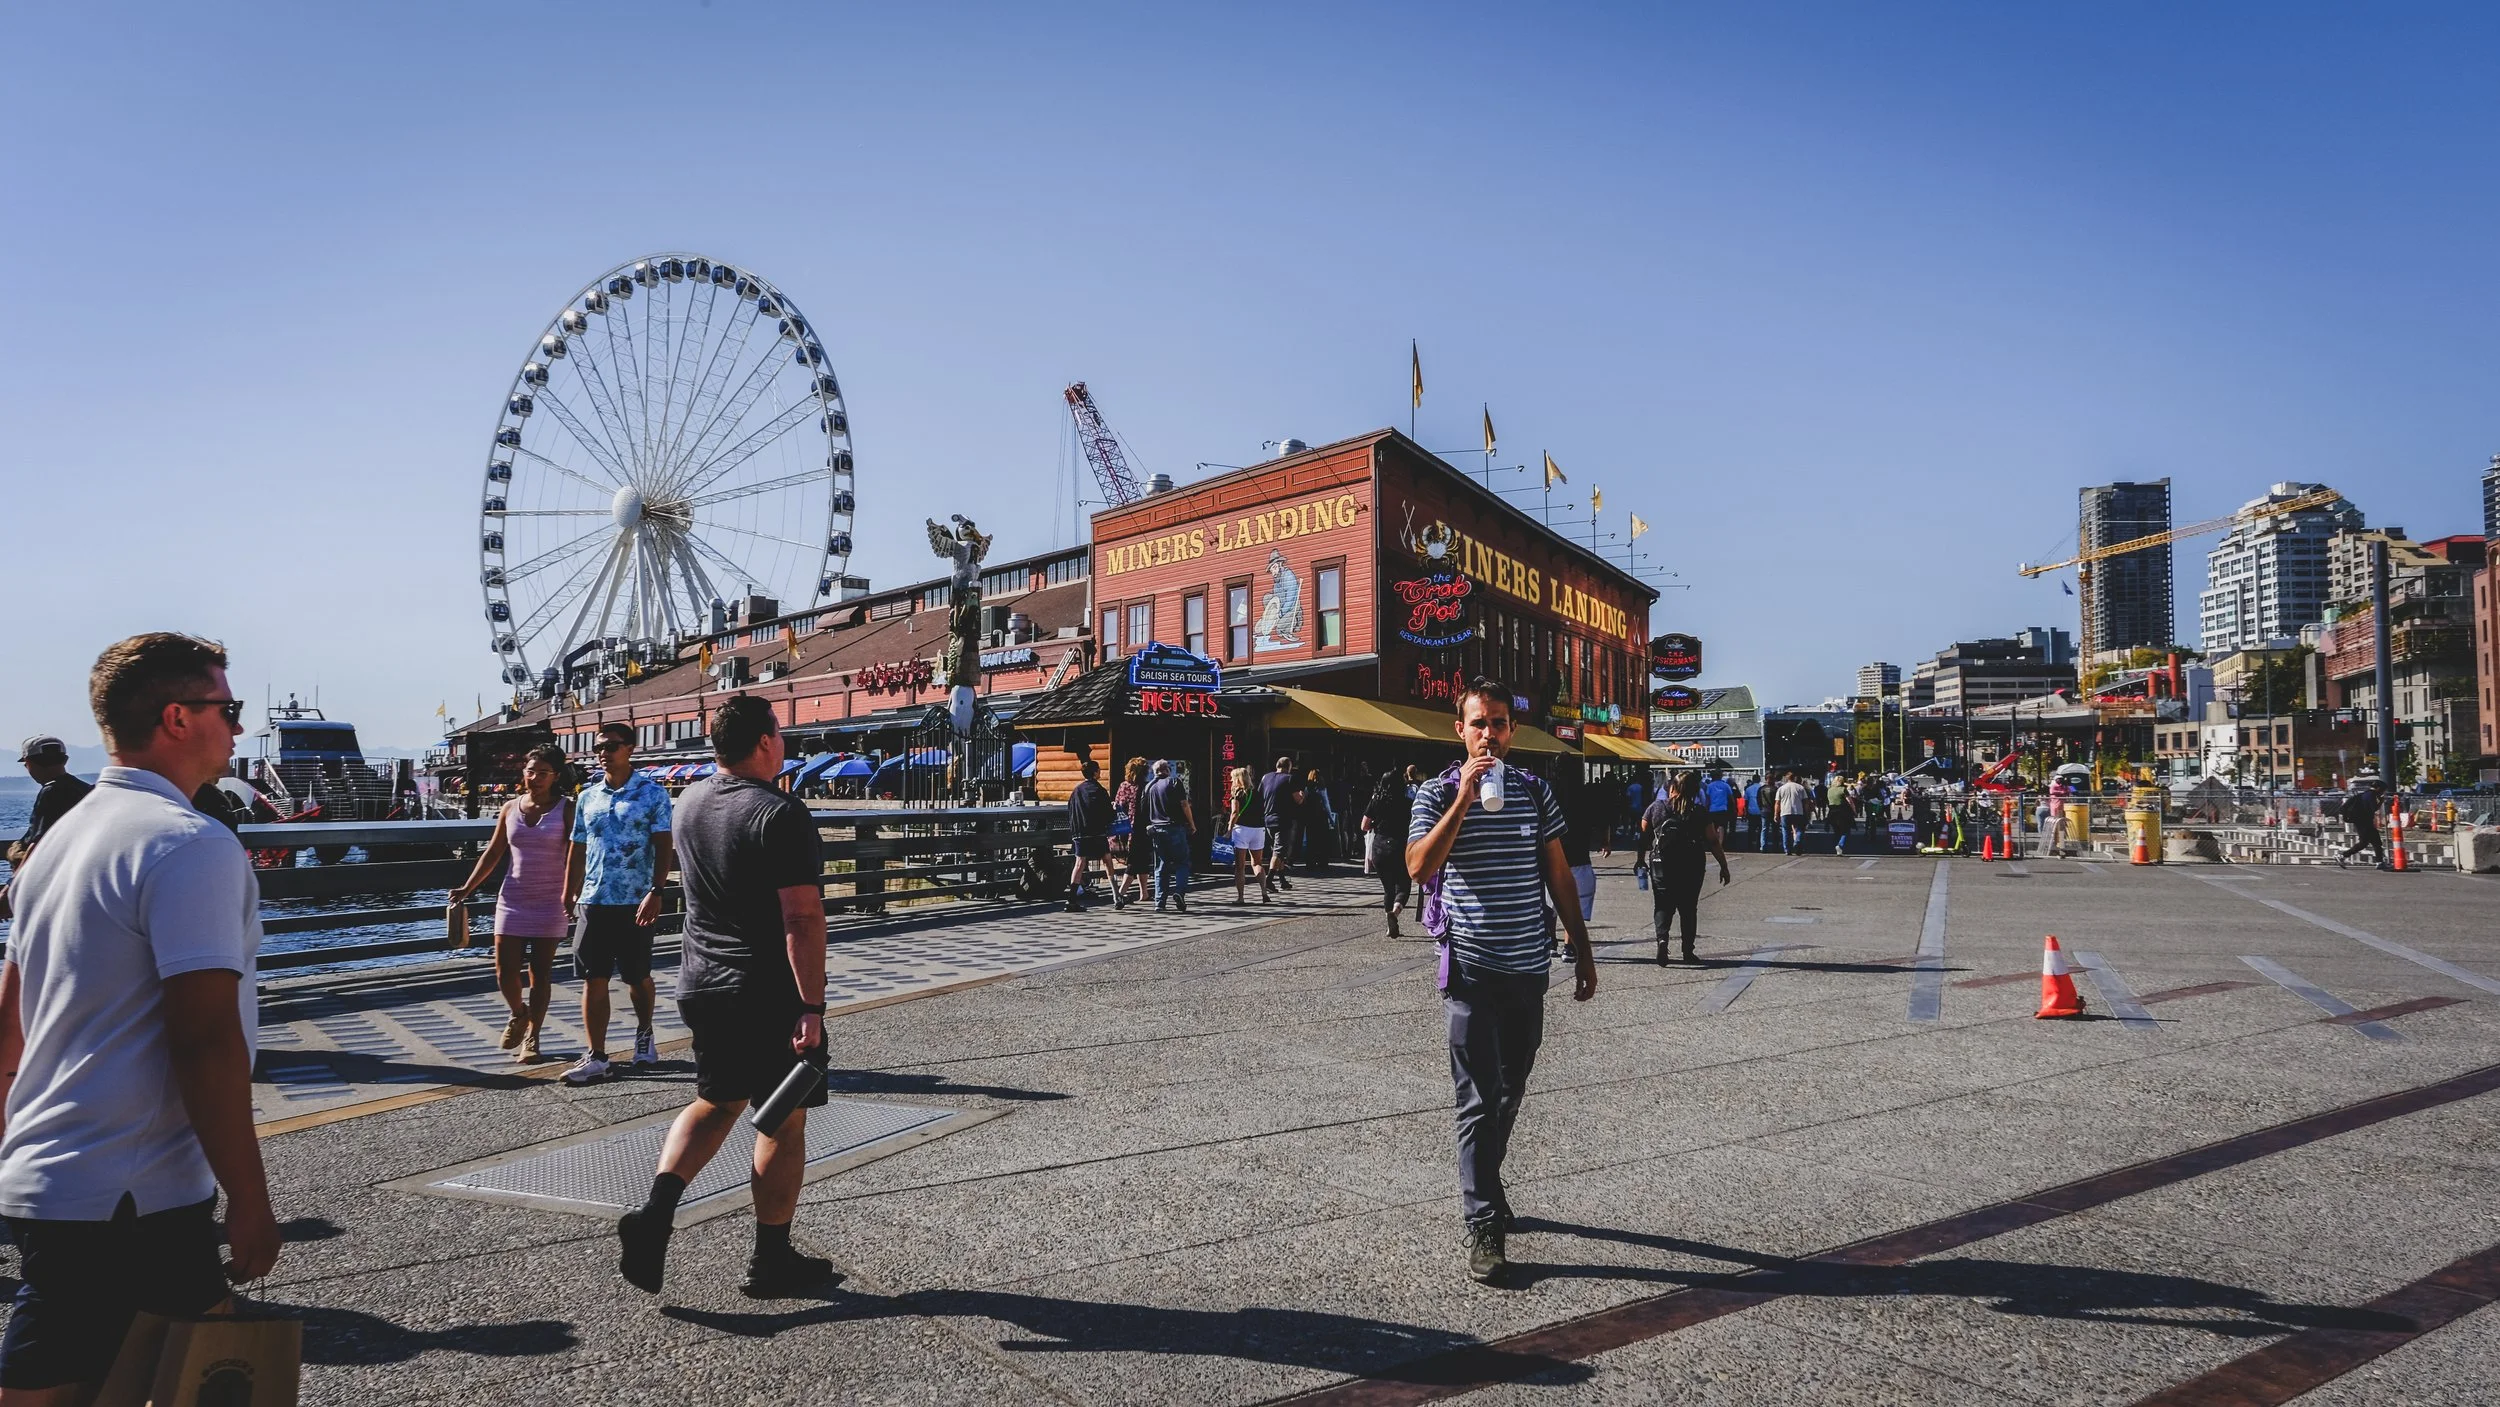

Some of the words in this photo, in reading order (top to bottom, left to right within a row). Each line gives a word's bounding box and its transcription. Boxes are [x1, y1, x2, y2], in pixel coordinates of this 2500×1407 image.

[1106, 528, 1205, 576] MINERS
[1216, 493, 1357, 553] LANDING
[1393, 574, 1472, 604] Crab
[1433, 573, 1451, 582] the
[1408, 599, 1461, 632] Pot
[1550, 577, 1628, 640] LANDING
[1399, 630, 1449, 647] RESTAURANT
[1457, 629, 1473, 643] BAR
[1140, 671, 1168, 681] SALISH
[1170, 672, 1185, 682] SEA
[1187, 673, 1213, 683] TOURS
[1139, 690, 1218, 714] TICKETS
